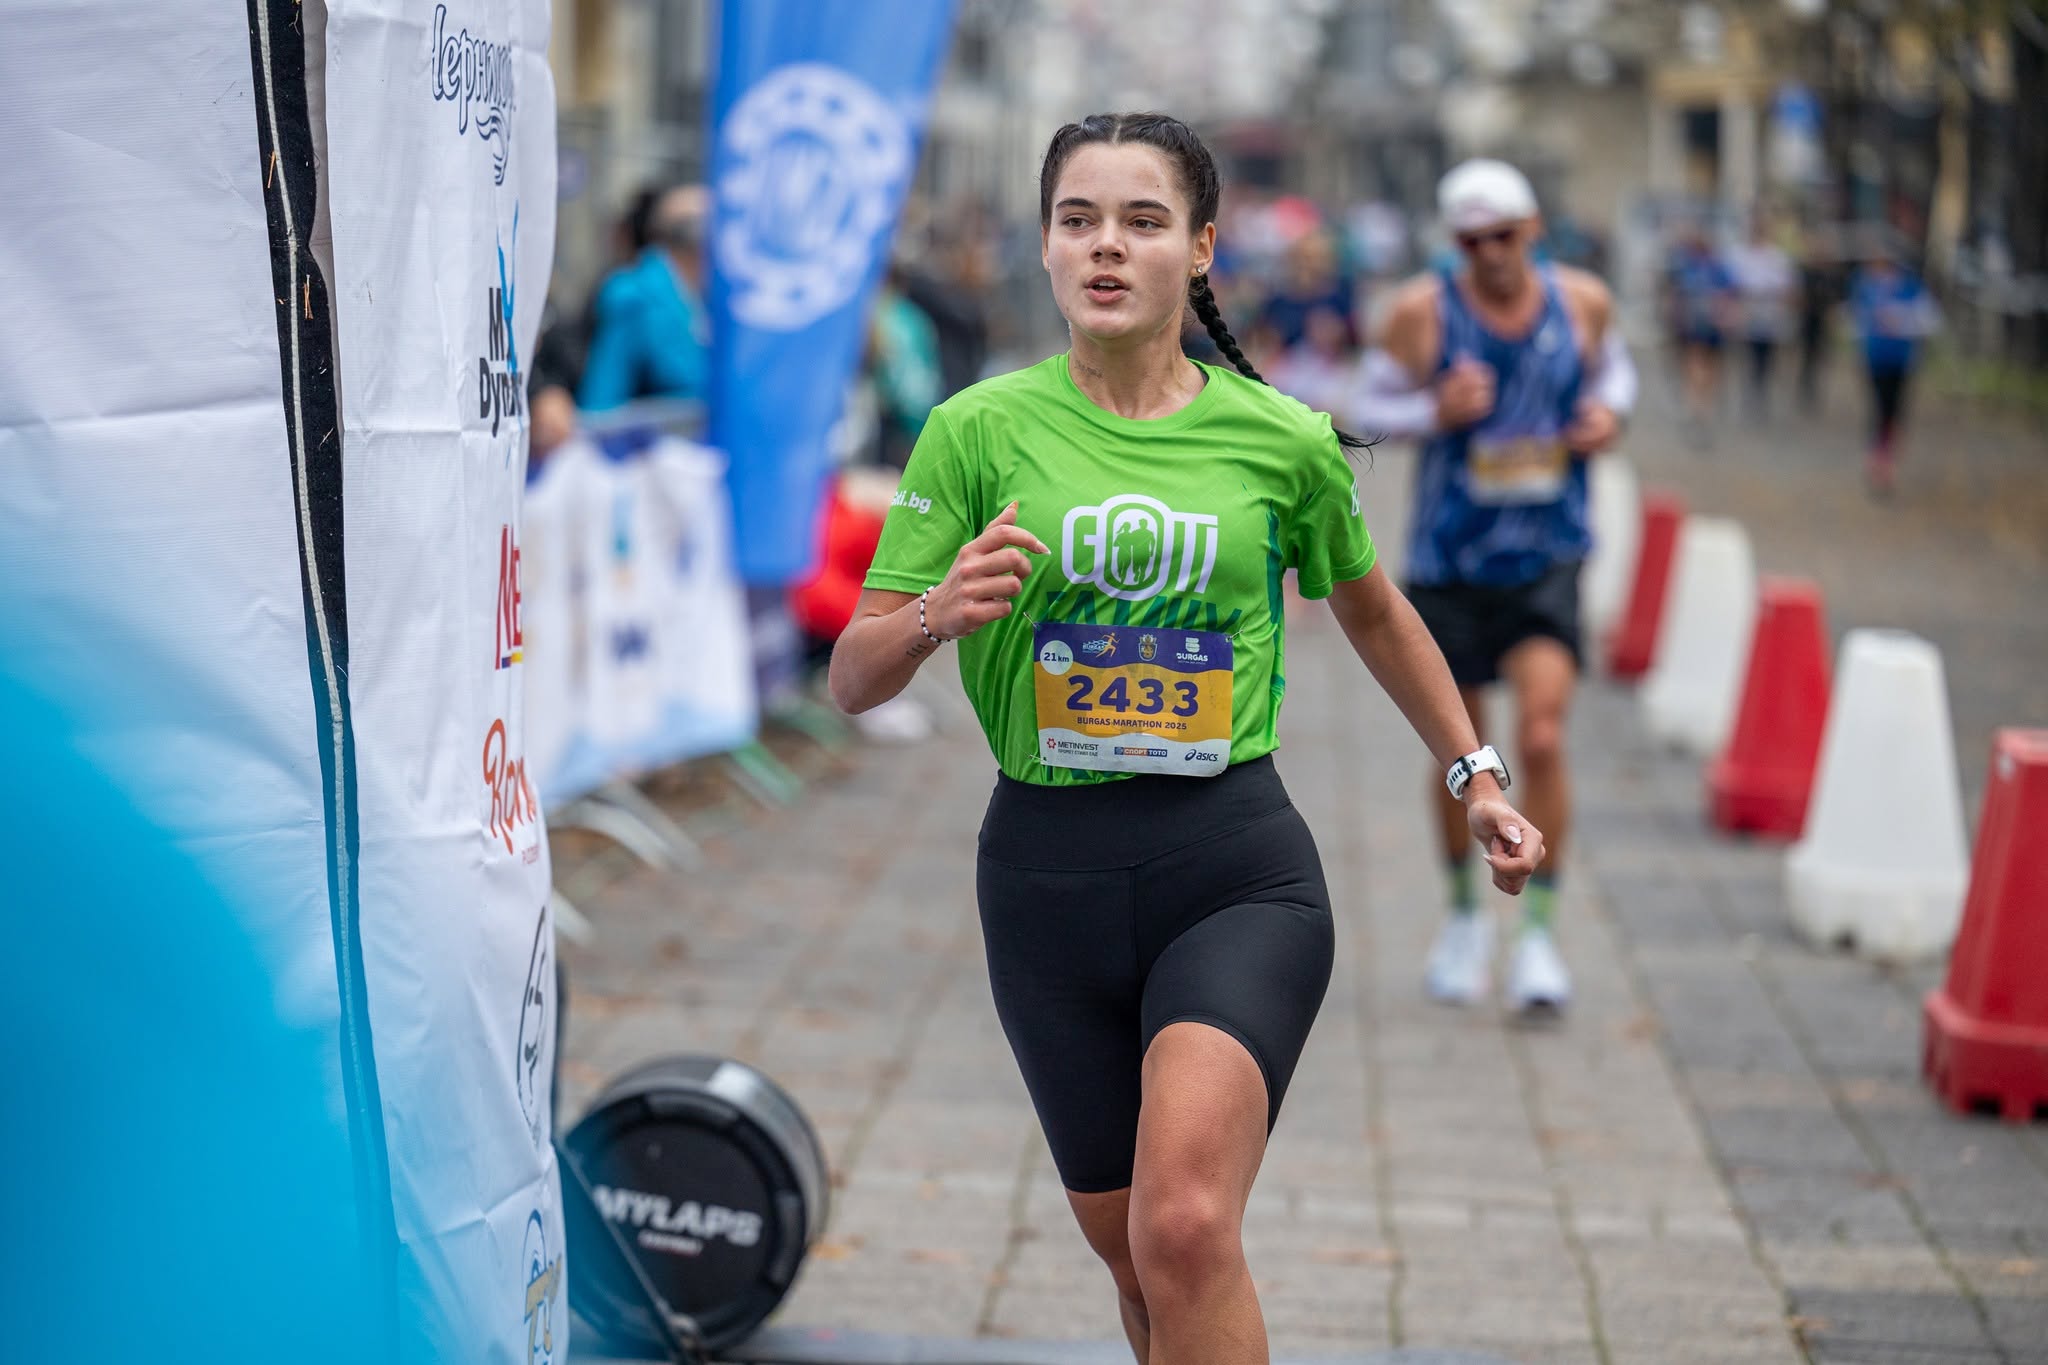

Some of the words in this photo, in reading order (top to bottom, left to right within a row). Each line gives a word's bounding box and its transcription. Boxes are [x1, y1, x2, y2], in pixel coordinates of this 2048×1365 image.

[1044, 652, 1057, 662] 21
[1057, 654, 1070, 663] km
[1066, 674, 1199, 717] 2433
[1077, 716, 1110, 726] BURGAS
[1112, 718, 1162, 729] MARATHON
[1165, 721, 1187, 730] 2025
[1057, 740, 1099, 751] METINVEST
[592, 1184, 763, 1247] MYLAPS
